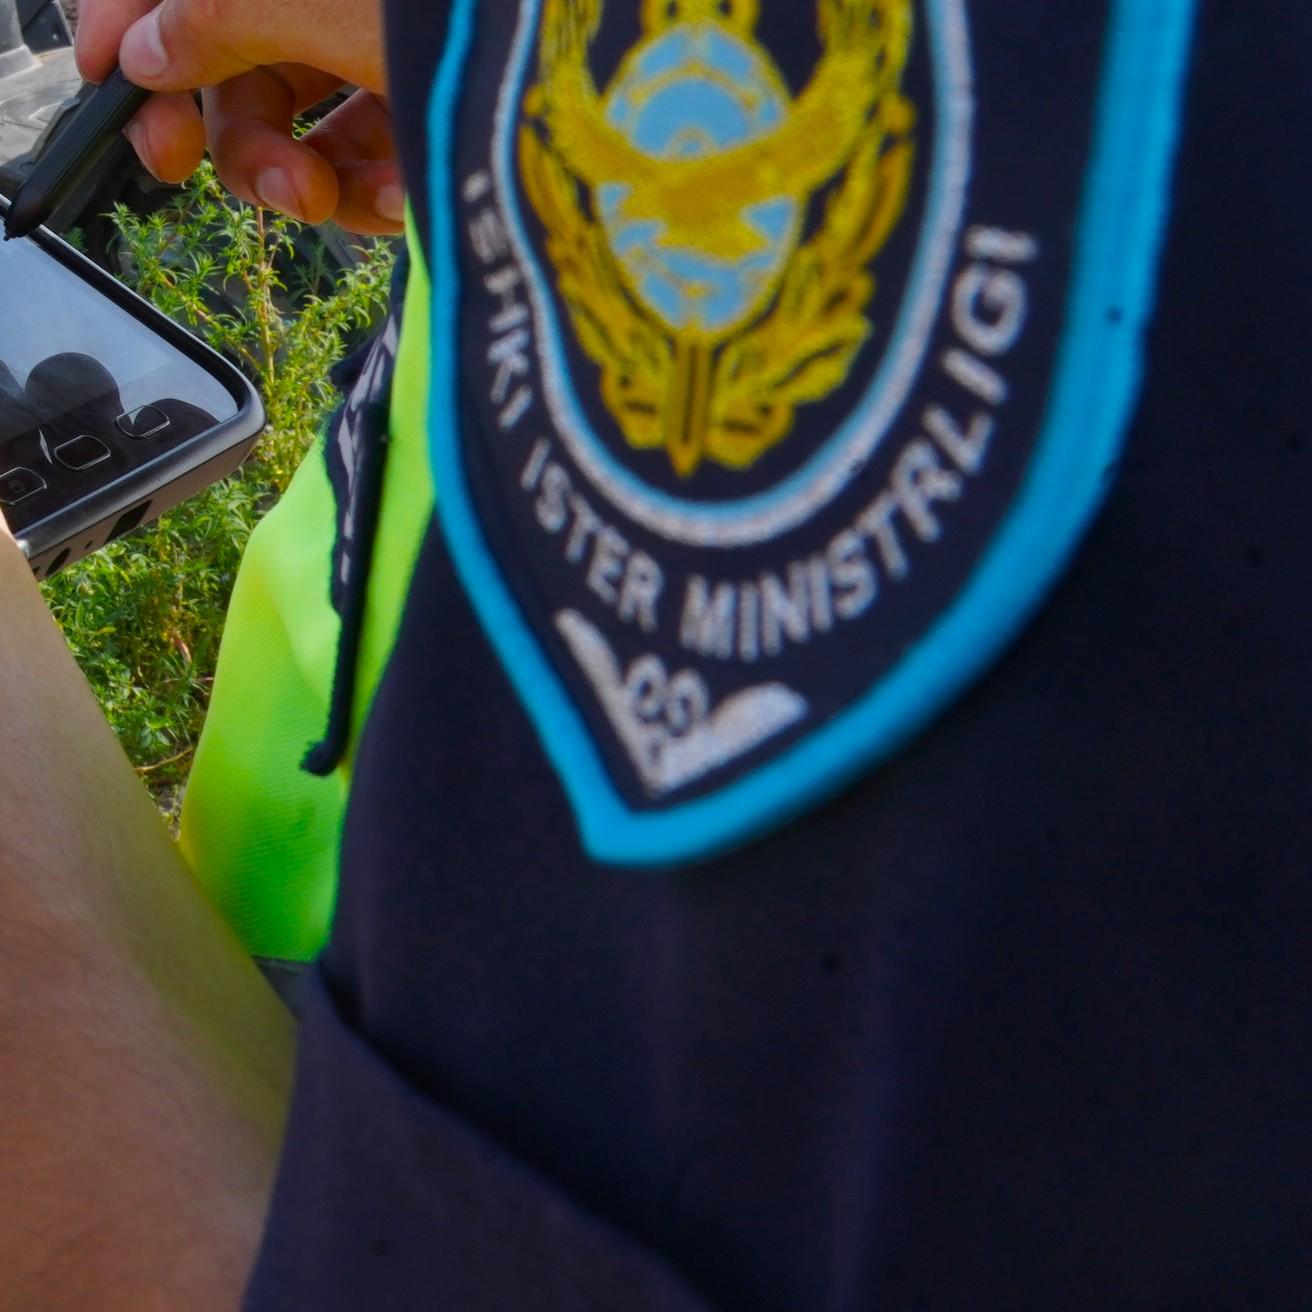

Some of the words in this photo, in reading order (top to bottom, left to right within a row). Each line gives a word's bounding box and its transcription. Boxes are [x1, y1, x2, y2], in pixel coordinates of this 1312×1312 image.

[463, 171, 532, 431] ISHKI
[521, 437, 665, 633] ISTER
[679, 224, 1039, 664] MINISTRLIGI
